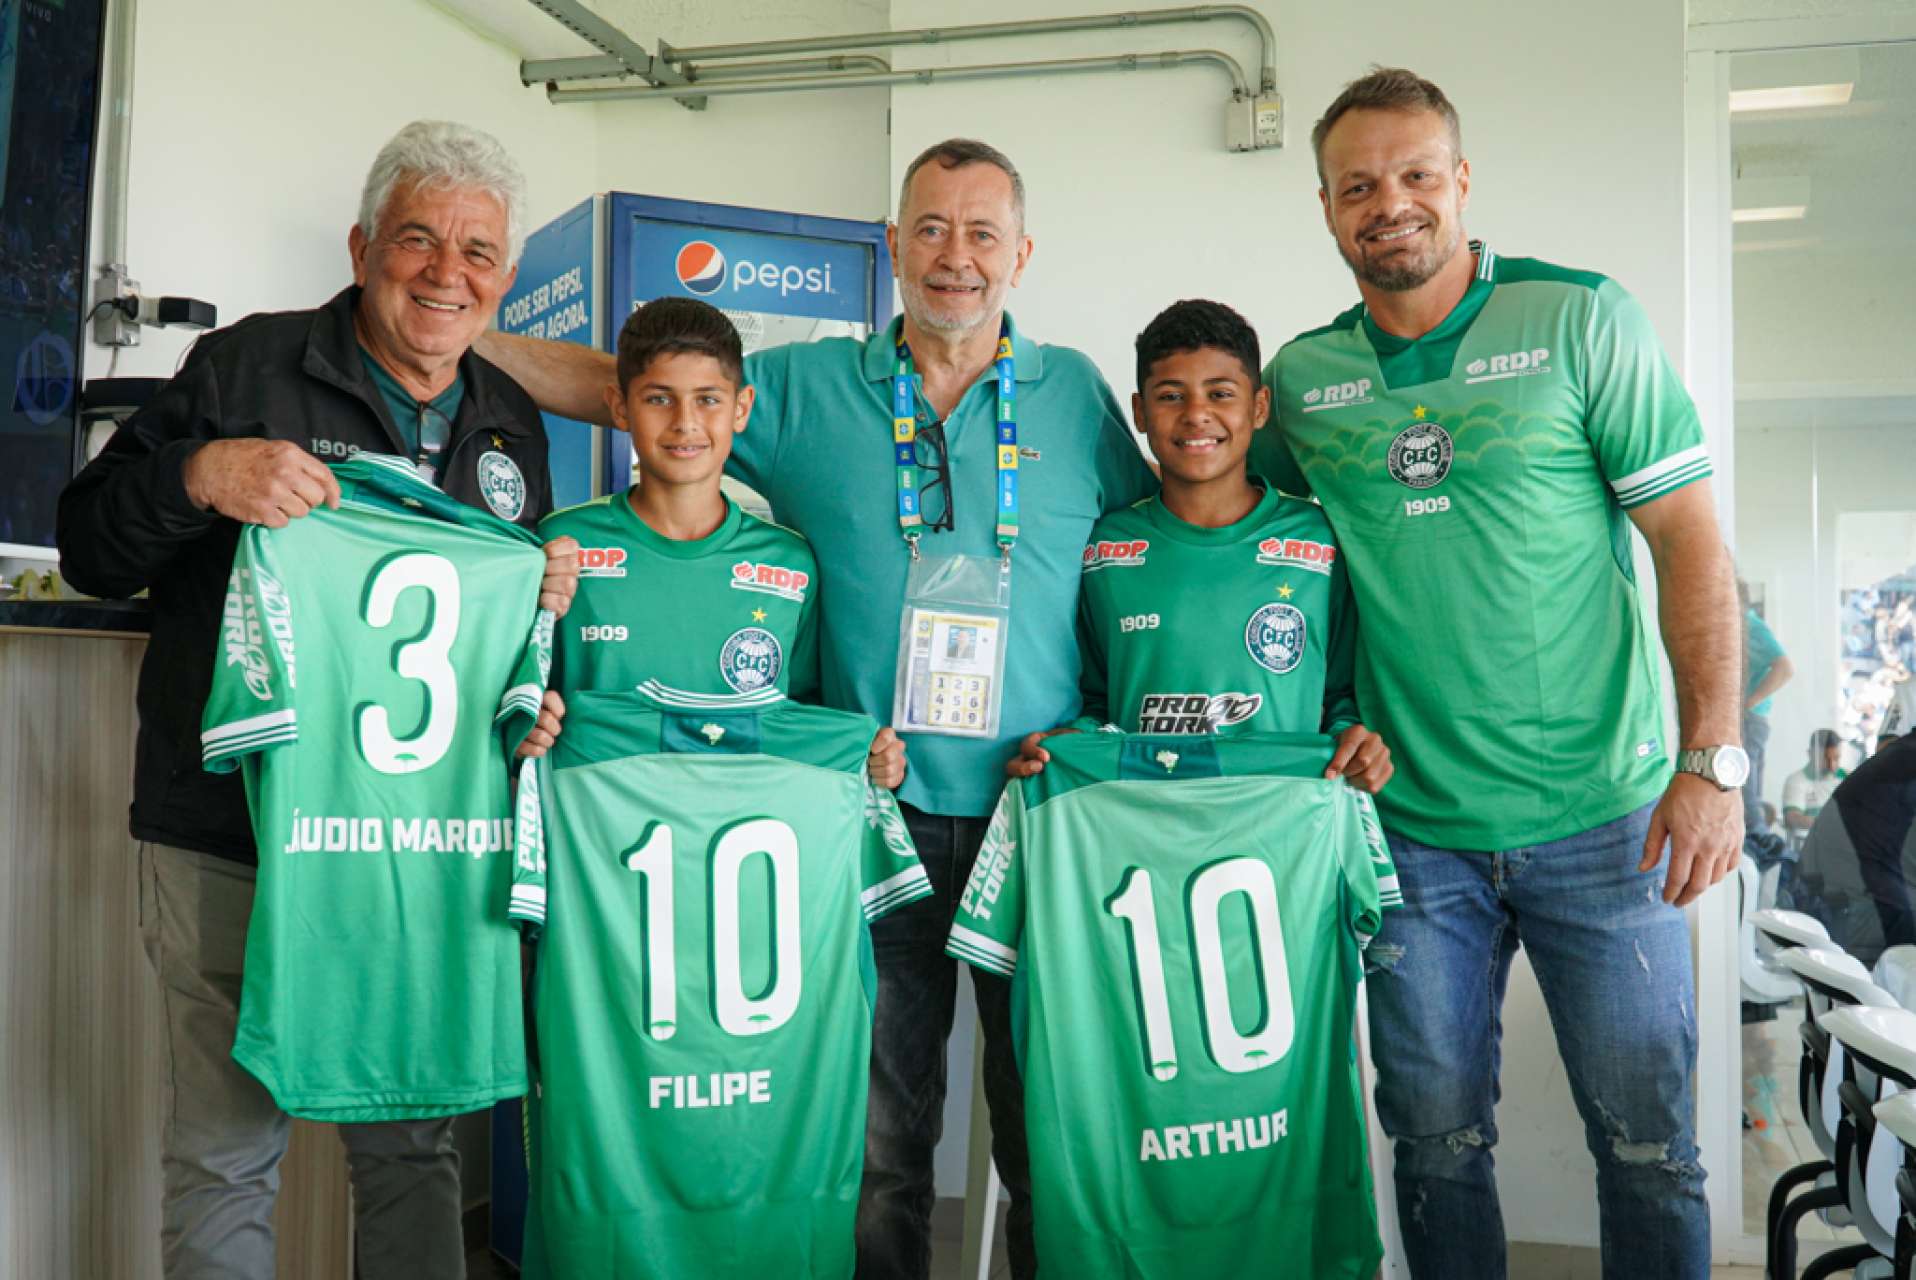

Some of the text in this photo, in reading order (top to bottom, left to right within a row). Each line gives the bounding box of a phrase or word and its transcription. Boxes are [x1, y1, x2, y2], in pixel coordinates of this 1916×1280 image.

[733, 260, 832, 297] pepsi
[504, 294, 531, 331] PODE
[532, 284, 551, 316] SER
[1490, 347, 1549, 373] RDP
[1324, 377, 1372, 402] RDP
[1402, 446, 1438, 465] CFC
[1405, 495, 1451, 517] 1909
[1098, 541, 1149, 559] RDP
[1285, 539, 1336, 564] RDP
[756, 565, 809, 592] RDP
[581, 624, 629, 642] 1909
[1119, 613, 1161, 633] 1909
[1262, 628, 1294, 648] CFC
[357, 551, 462, 775] 3
[1141, 697, 1208, 714] PRO
[1140, 716, 1216, 734] TORK
[518, 794, 538, 871] PRO
[973, 841, 1017, 920] TORK
[624, 817, 802, 1041] 10
[1106, 856, 1296, 1081] 10
[648, 1069, 772, 1109] FILIPE
[1140, 1107, 1288, 1162] ARTHUR
